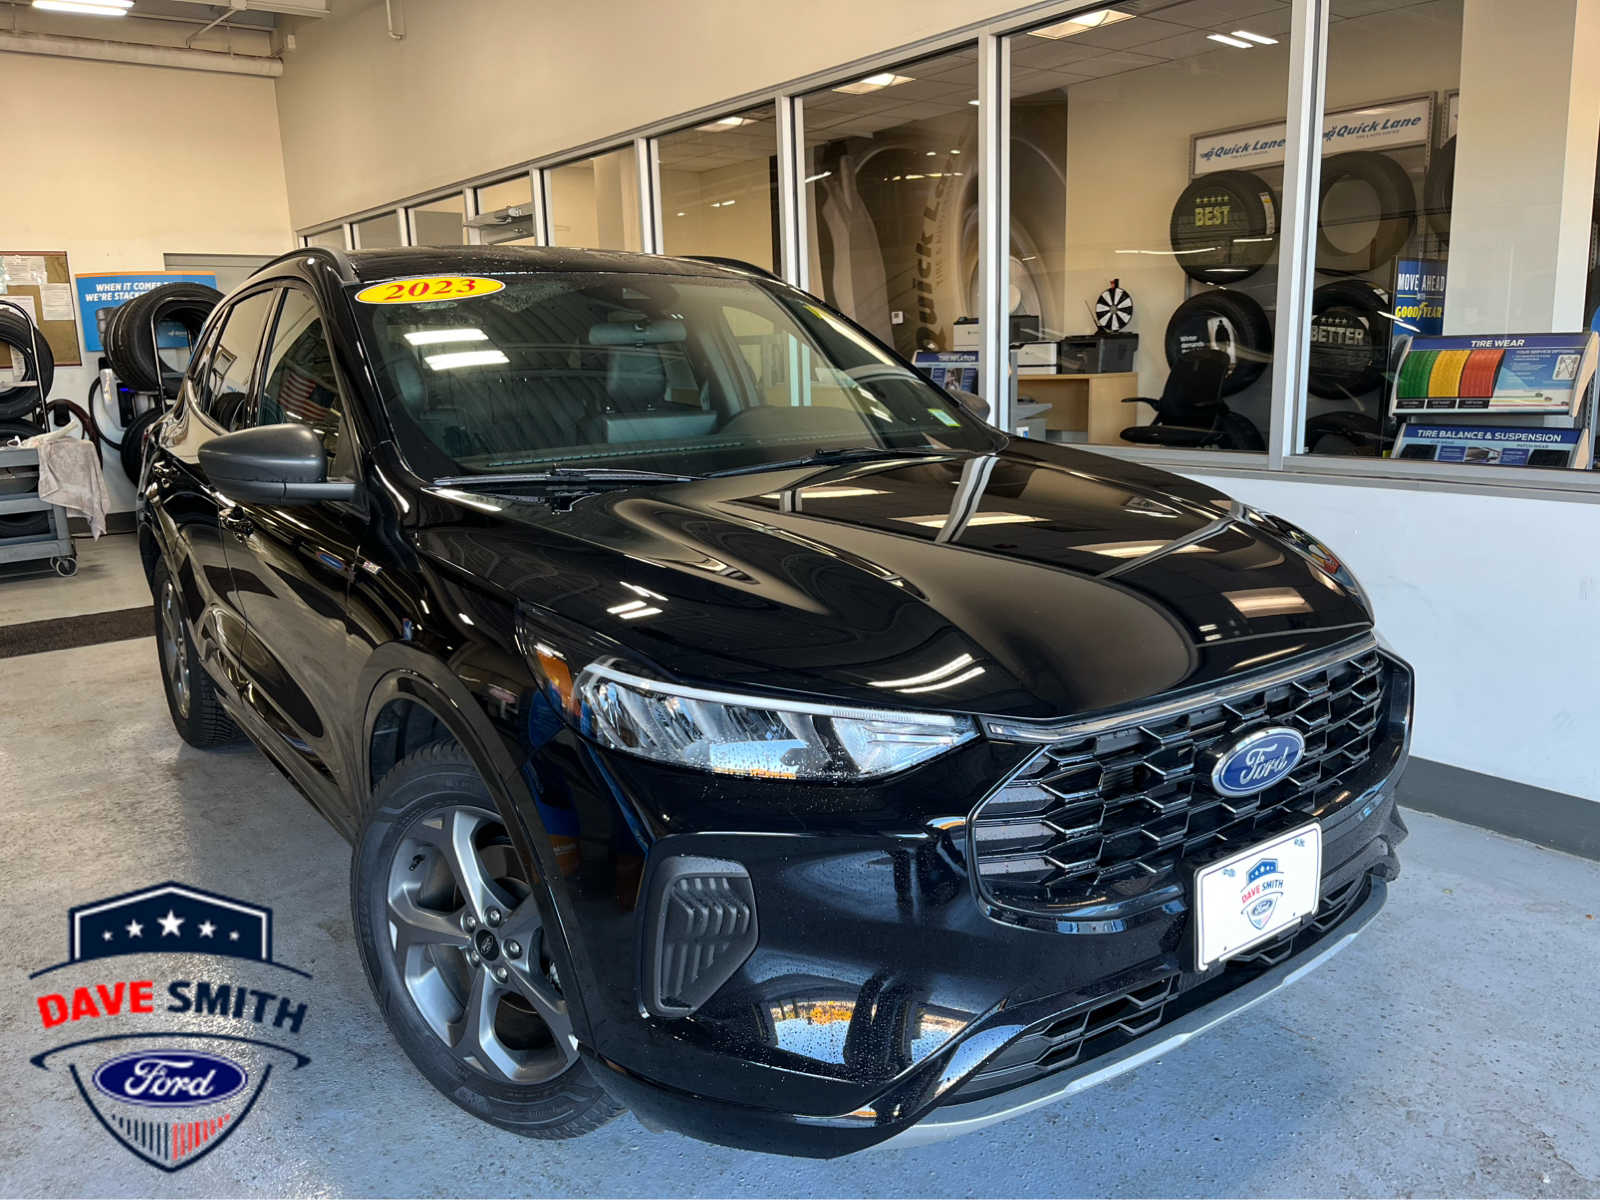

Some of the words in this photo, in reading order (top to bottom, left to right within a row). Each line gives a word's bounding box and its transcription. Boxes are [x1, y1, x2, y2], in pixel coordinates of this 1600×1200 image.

[1336, 120, 1380, 137] Quick
[1381, 116, 1422, 130] Lane
[1215, 142, 1251, 158] Quick
[1252, 138, 1286, 151] Lane
[1194, 206, 1232, 227] BEST
[96, 282, 122, 292] WHEN
[123, 282, 132, 291] IT
[384, 278, 477, 300] 2023
[1397, 273, 1420, 291] MOVE
[1421, 275, 1445, 292] AHEAD
[85, 292, 113, 302] WE'RE
[1311, 325, 1365, 345] BETTER
[1471, 340, 1493, 348] TIRE
[1494, 339, 1525, 347] WEAR
[1417, 429, 1438, 438] TIRE
[1439, 430, 1484, 439] BALANCE
[1484, 432, 1492, 440] &
[1494, 432, 1562, 442] SUSPENSION
[1240, 743, 1290, 785] Ford
[1241, 884, 1261, 904] DAVE
[1261, 879, 1284, 892] SMITH
